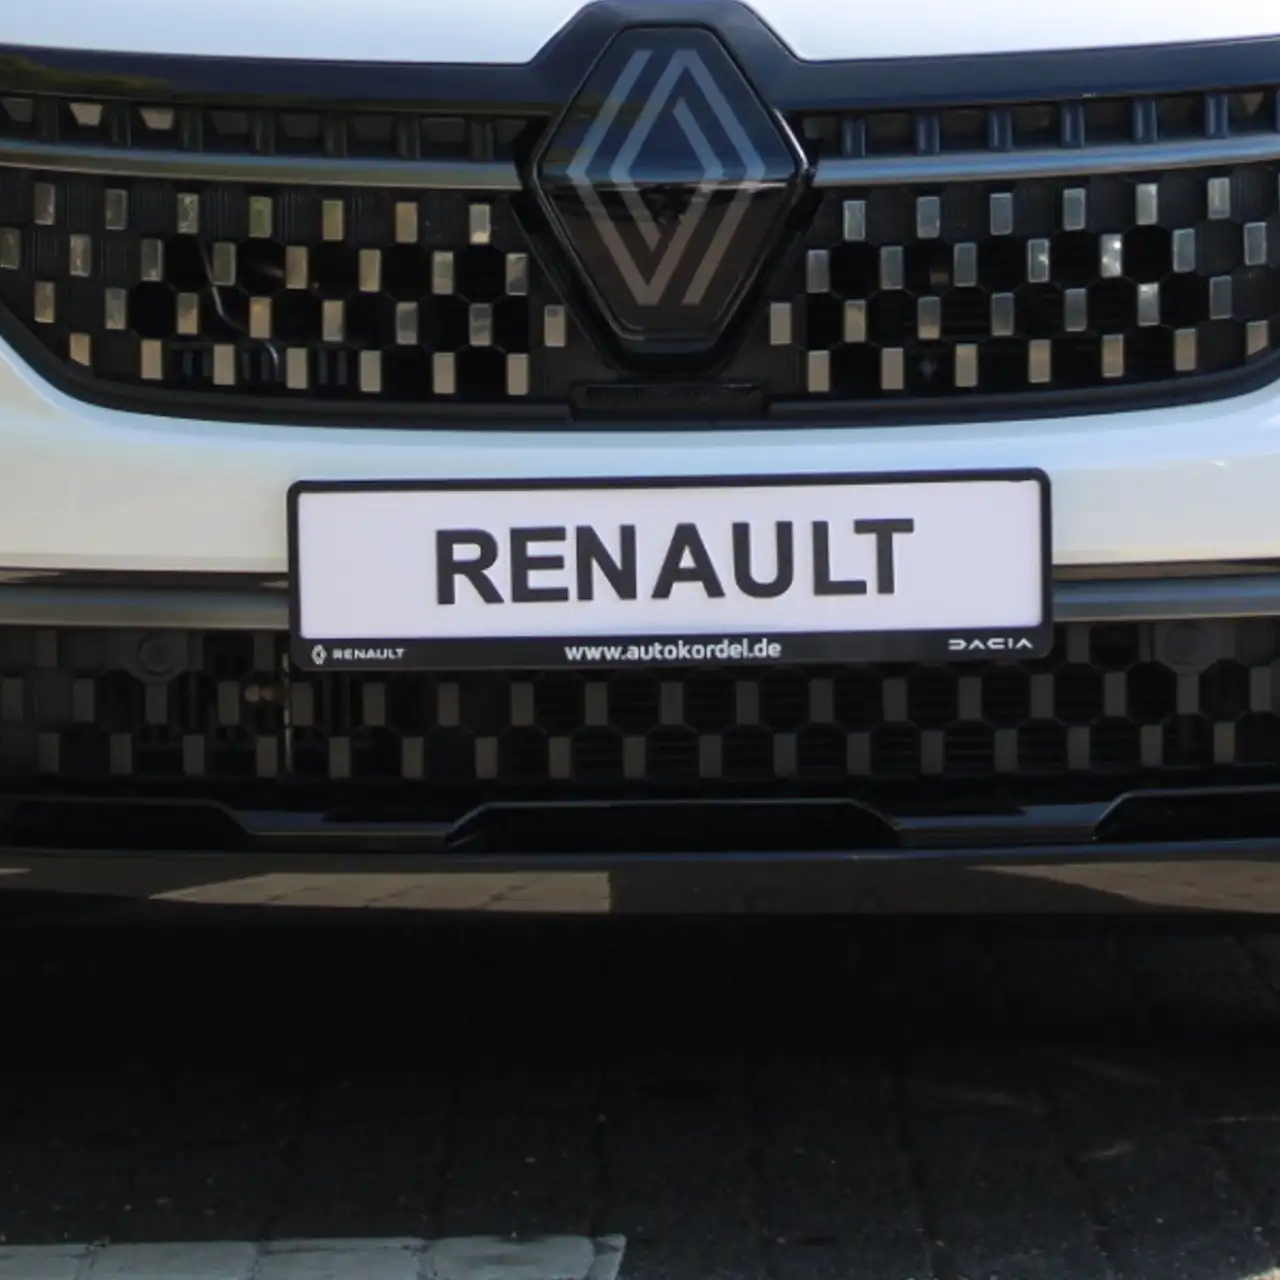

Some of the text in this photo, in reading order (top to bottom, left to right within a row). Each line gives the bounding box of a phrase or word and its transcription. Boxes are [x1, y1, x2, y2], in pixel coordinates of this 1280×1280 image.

[434, 517, 915, 606] RENAULT
[332, 647, 406, 660] RENAULT
[564, 637, 782, 662] www.autokordel.de
[947, 637, 1034, 651] DACIA
